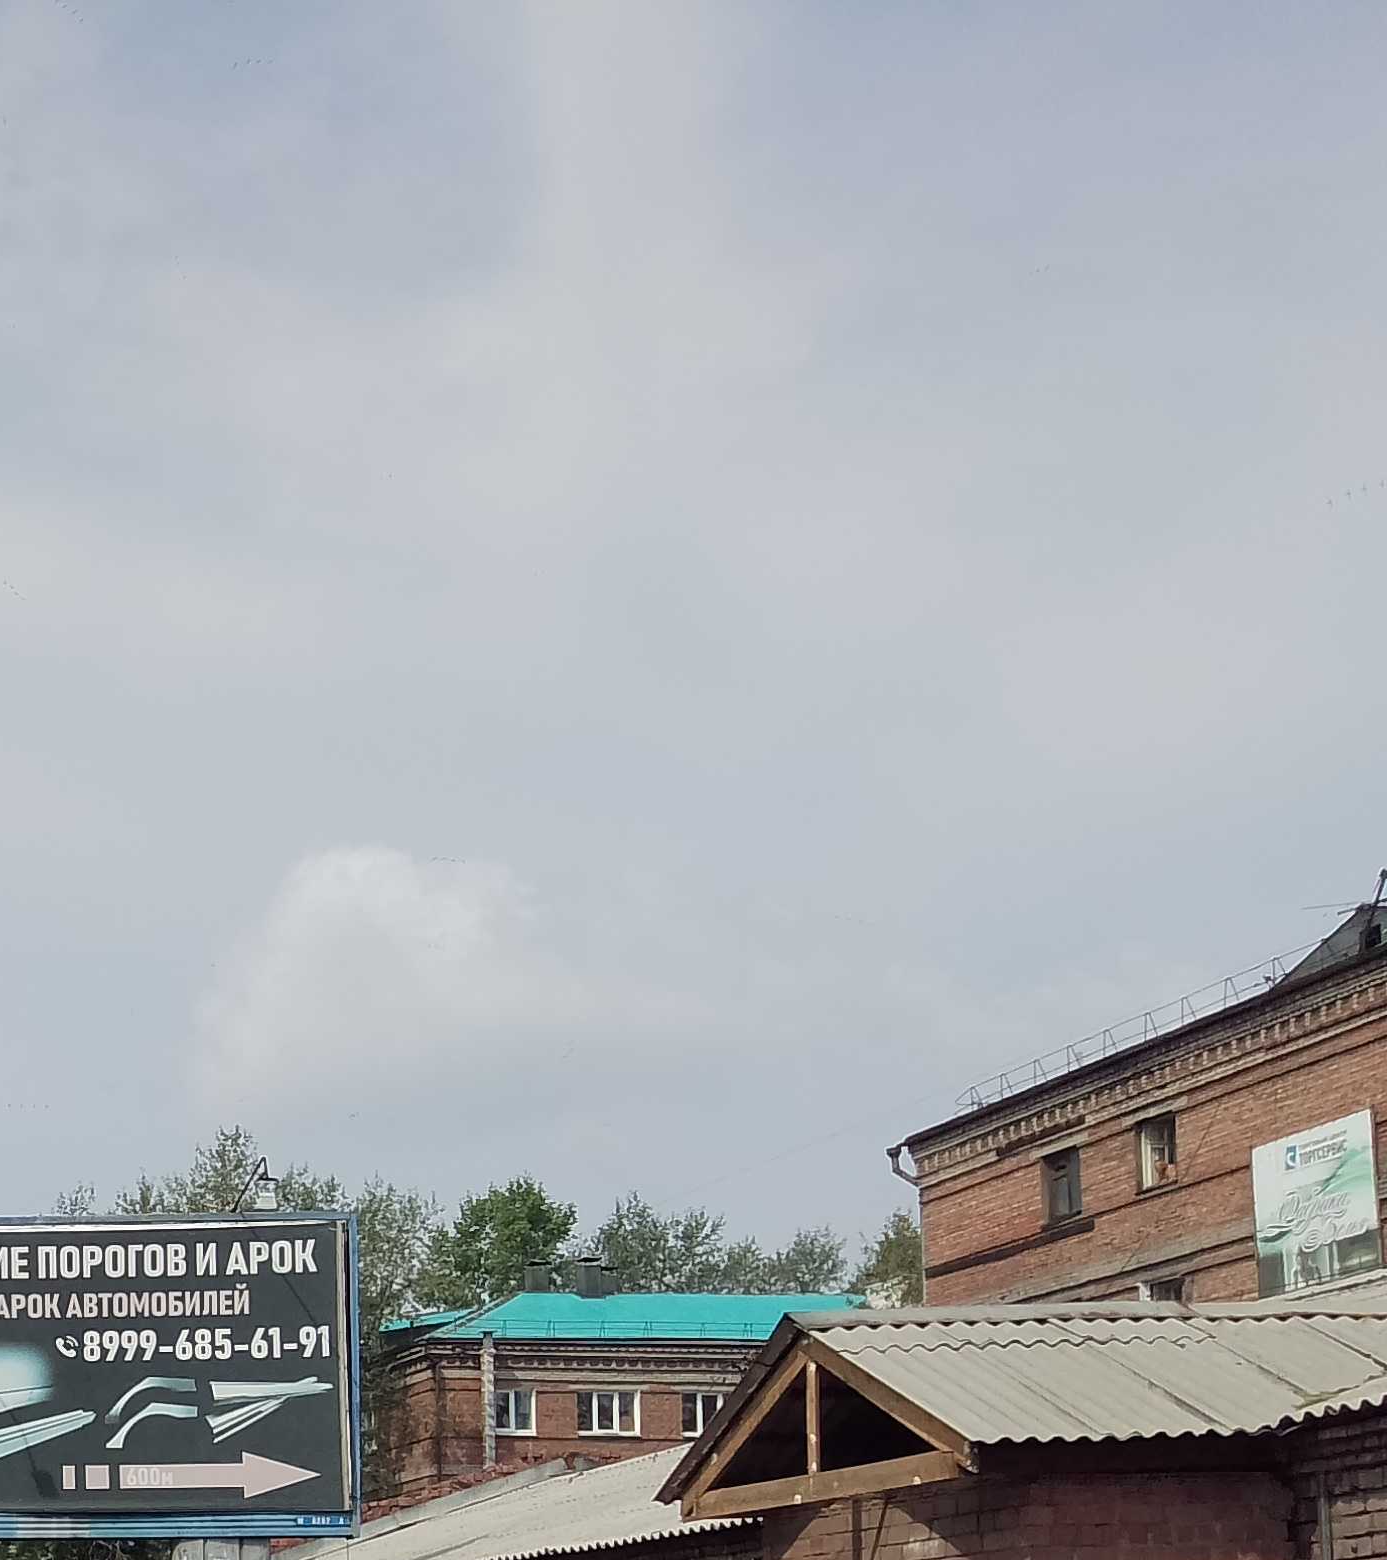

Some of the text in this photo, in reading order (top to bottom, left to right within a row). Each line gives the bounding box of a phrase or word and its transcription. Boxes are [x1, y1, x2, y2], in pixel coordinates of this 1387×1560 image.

[37, 1243, 187, 1279] ПОРОГОВ
[195, 1242, 217, 1277] И
[225, 1238, 319, 1276] АРОК
[65, 1282, 251, 1319] АВТОМОБИЛЕЙ
[82, 1324, 331, 1362] 8999-685-61-91
